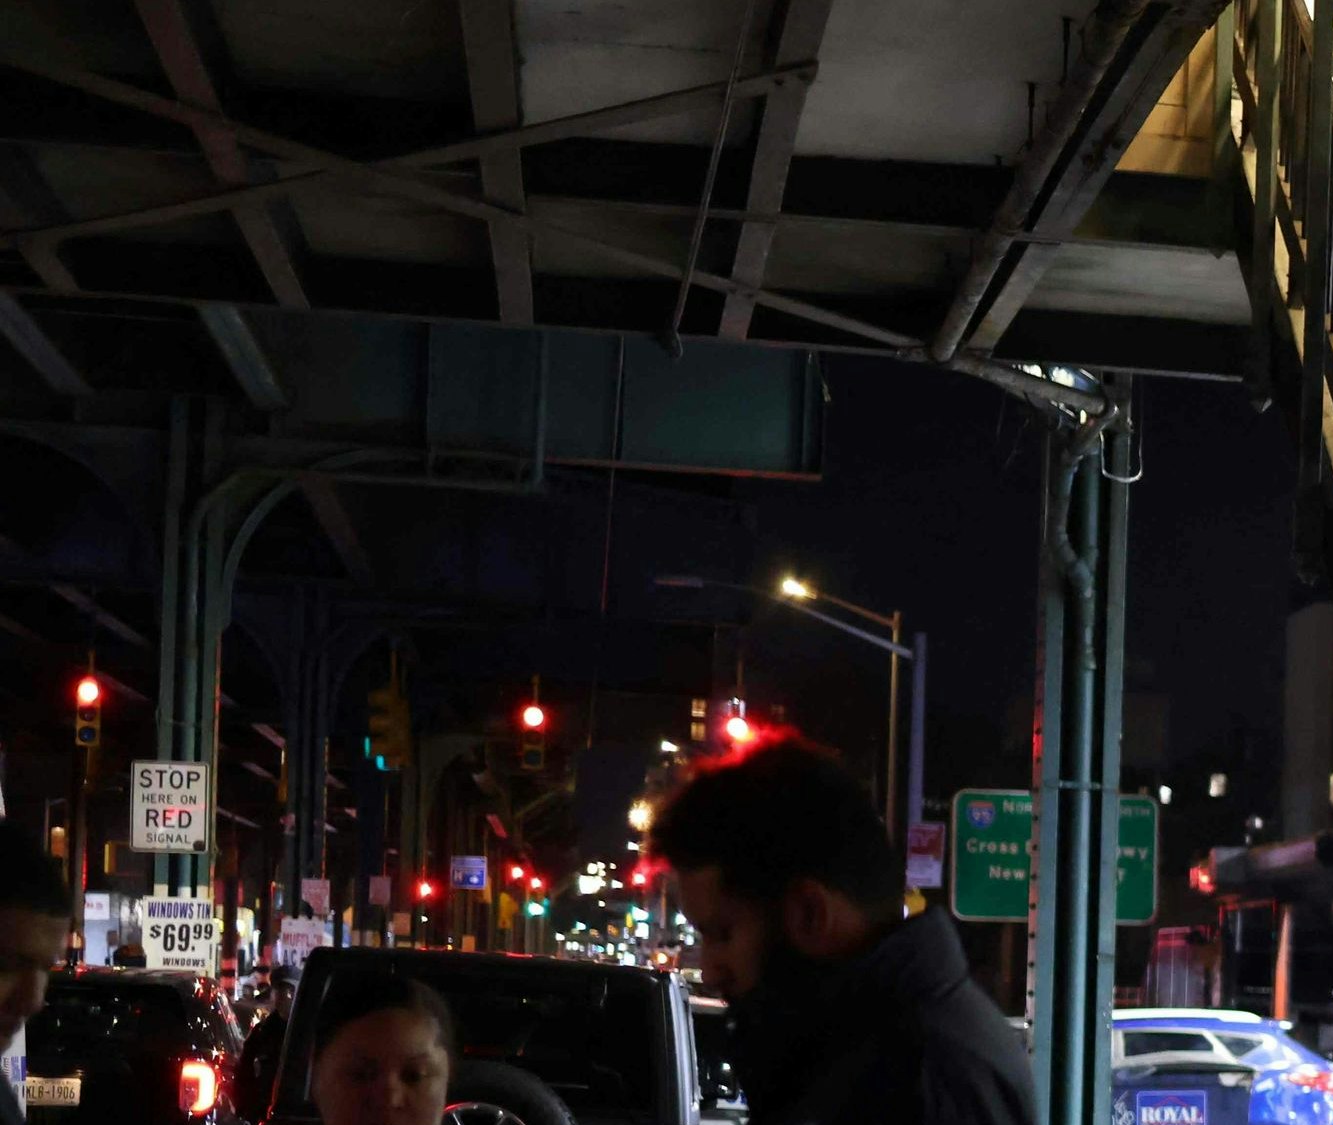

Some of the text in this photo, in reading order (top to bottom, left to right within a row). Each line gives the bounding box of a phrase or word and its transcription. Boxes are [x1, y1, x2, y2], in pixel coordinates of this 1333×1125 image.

[140, 769, 201, 789] STOP
[142, 793, 197, 804] HERE ON
[145, 809, 192, 828] RED
[146, 833, 191, 844] SIGNAL
[966, 838, 1019, 854] Cross
[989, 865, 1025, 880] New
[147, 902, 193, 919] WINDOWS
[162, 957, 206, 968] WINDOWS
[1141, 1106, 1203, 1124] ROYAL
